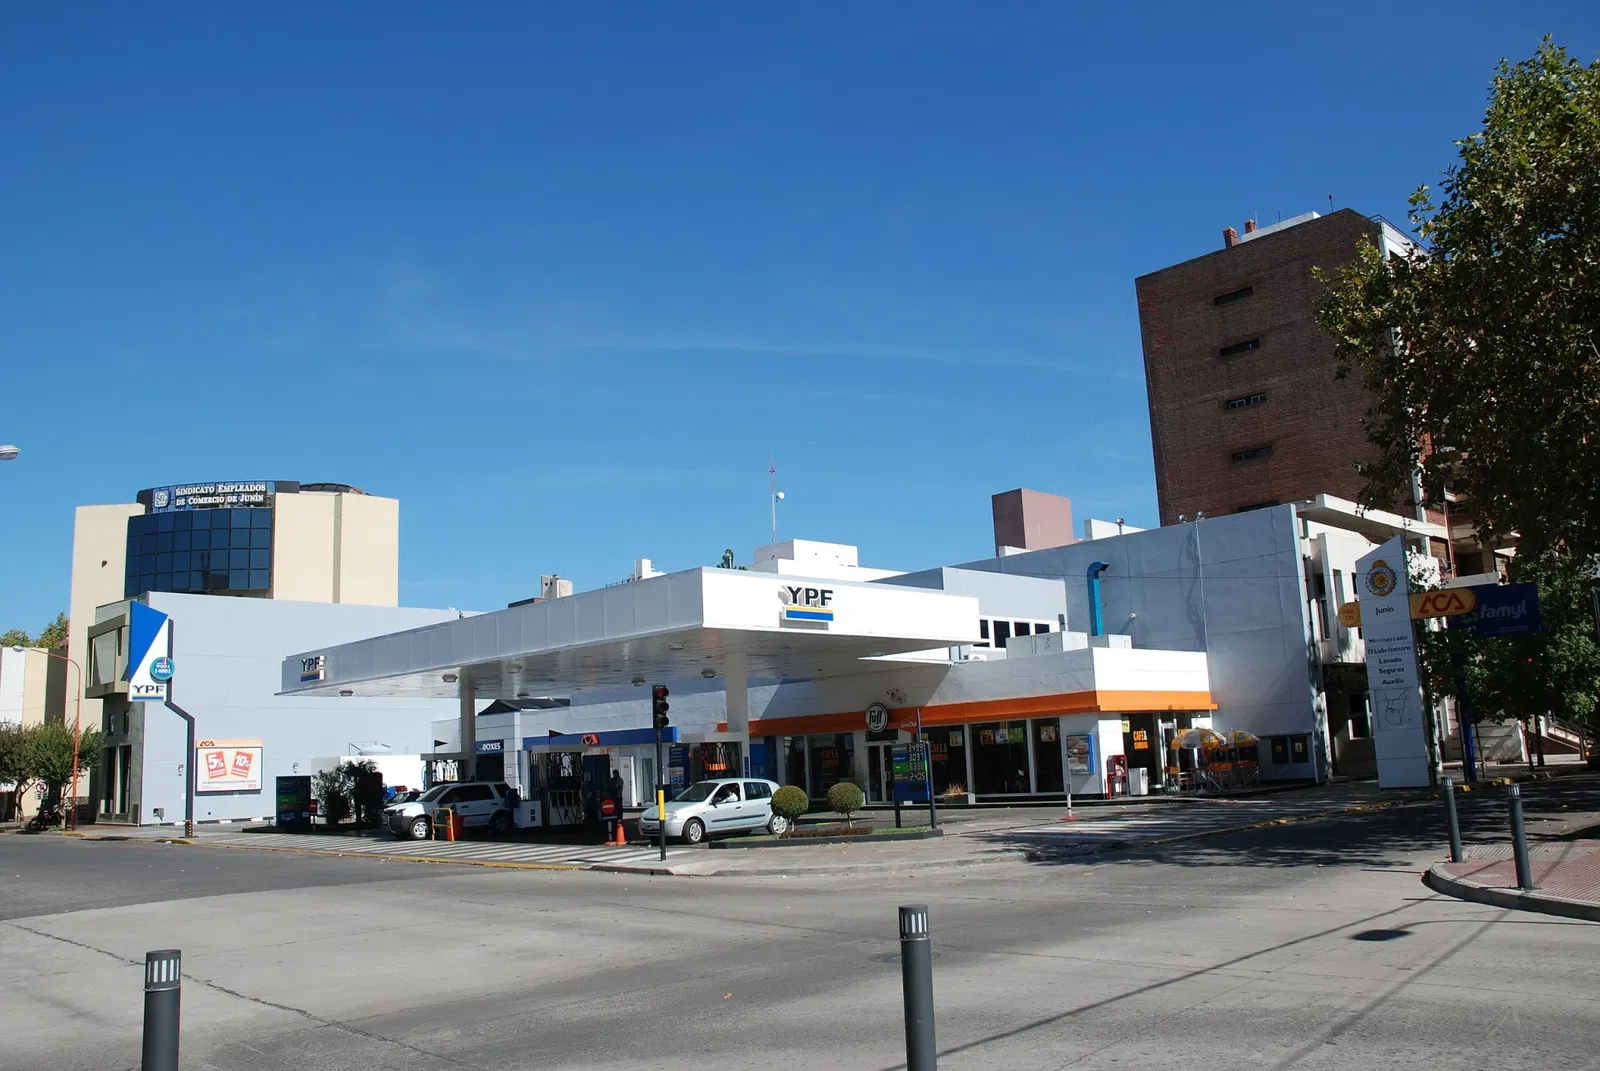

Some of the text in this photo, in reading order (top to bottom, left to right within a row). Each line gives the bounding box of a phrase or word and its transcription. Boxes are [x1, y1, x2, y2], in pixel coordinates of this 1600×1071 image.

[176, 484, 266, 496] SINDICATO EMPLEADOS
[176, 498, 186, 506] DE
[188, 496, 225, 505] COMERCIO
[786, 586, 834, 606] YPF
[1419, 592, 1466, 614] ACA
[1480, 600, 1527, 619] famyl
[1369, 635, 1408, 644] Minimercado
[1374, 646, 1411, 654] Lubricentro
[301, 656, 320, 671] YPF
[132, 685, 164, 693] YPF
[482, 742, 500, 750] BOXES
